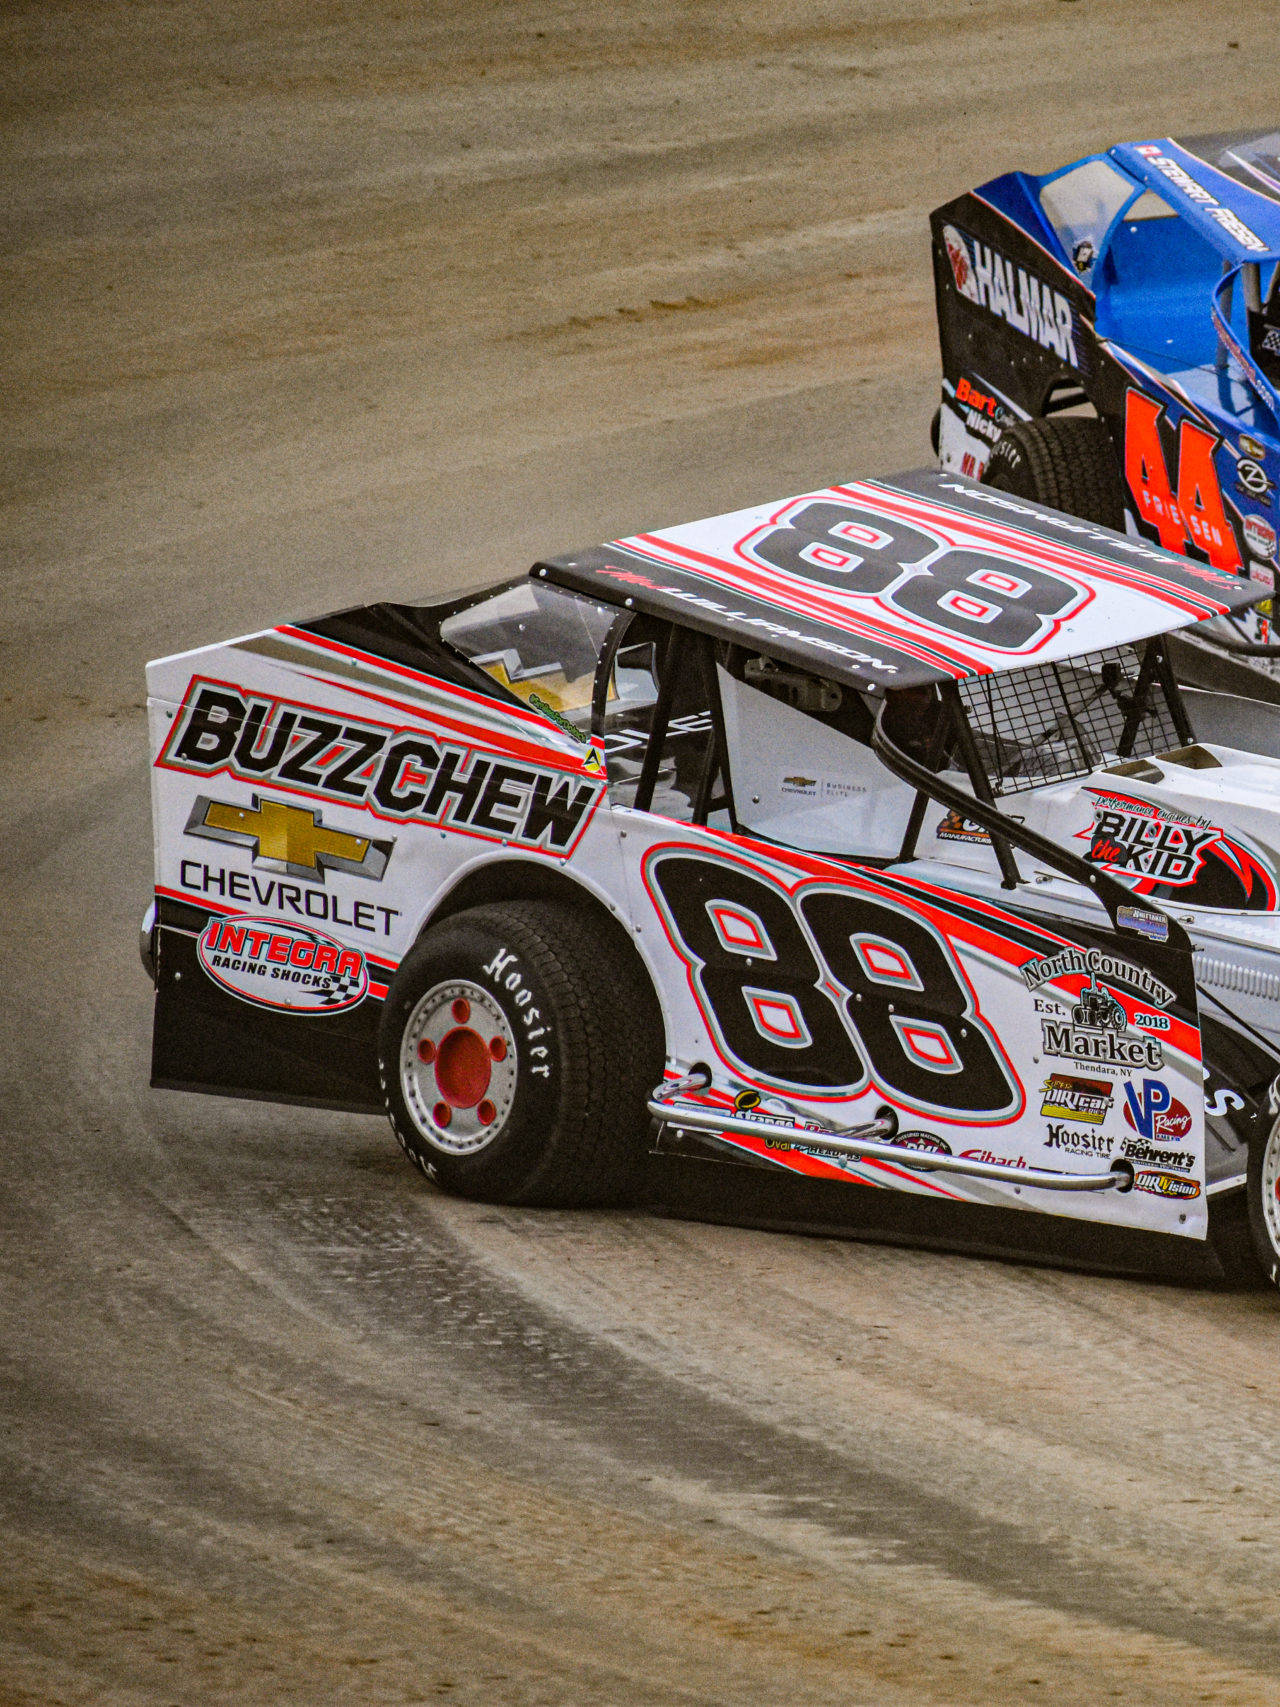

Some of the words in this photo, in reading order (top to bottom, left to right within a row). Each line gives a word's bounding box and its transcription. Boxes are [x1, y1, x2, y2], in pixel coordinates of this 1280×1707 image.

[1146, 156, 1221, 207] STEWART
[973, 239, 1079, 369] HALMAR
[750, 500, 1081, 649] 88
[656, 587, 900, 673] WILLIAMSON
[172, 685, 599, 851] BUZZCHEW
[1093, 810, 1217, 856] BILLY
[1195, 815, 1212, 831] by
[1090, 838, 1121, 863] the
[1125, 843, 1196, 880] KID
[180, 860, 400, 936] CHEVROLET
[205, 921, 364, 980] INTEGRA
[212, 954, 268, 977] RACING
[270, 967, 333, 989] SHOCKS
[649, 852, 1018, 1115] 88
[1022, 949, 1084, 988] North
[1086, 949, 1177, 1007] Country
[482, 947, 551, 1079] Hoosier
[1033, 998, 1066, 1016] Est.
[1134, 1012, 1171, 1030] 2018
[1043, 1023, 1163, 1067] Market
[1073, 1061, 1119, 1077] Thendara,
[1119, 1067, 1133, 1078] NY
[1123, 1078, 1171, 1140] VP
[1155, 1113, 1192, 1134] Racing
[1043, 1122, 1115, 1154] Hoosier
[1064, 1147, 1094, 1158] RACING
[1096, 1151, 1111, 1160] TIRE
[1123, 1142, 1196, 1168] Behrent's
